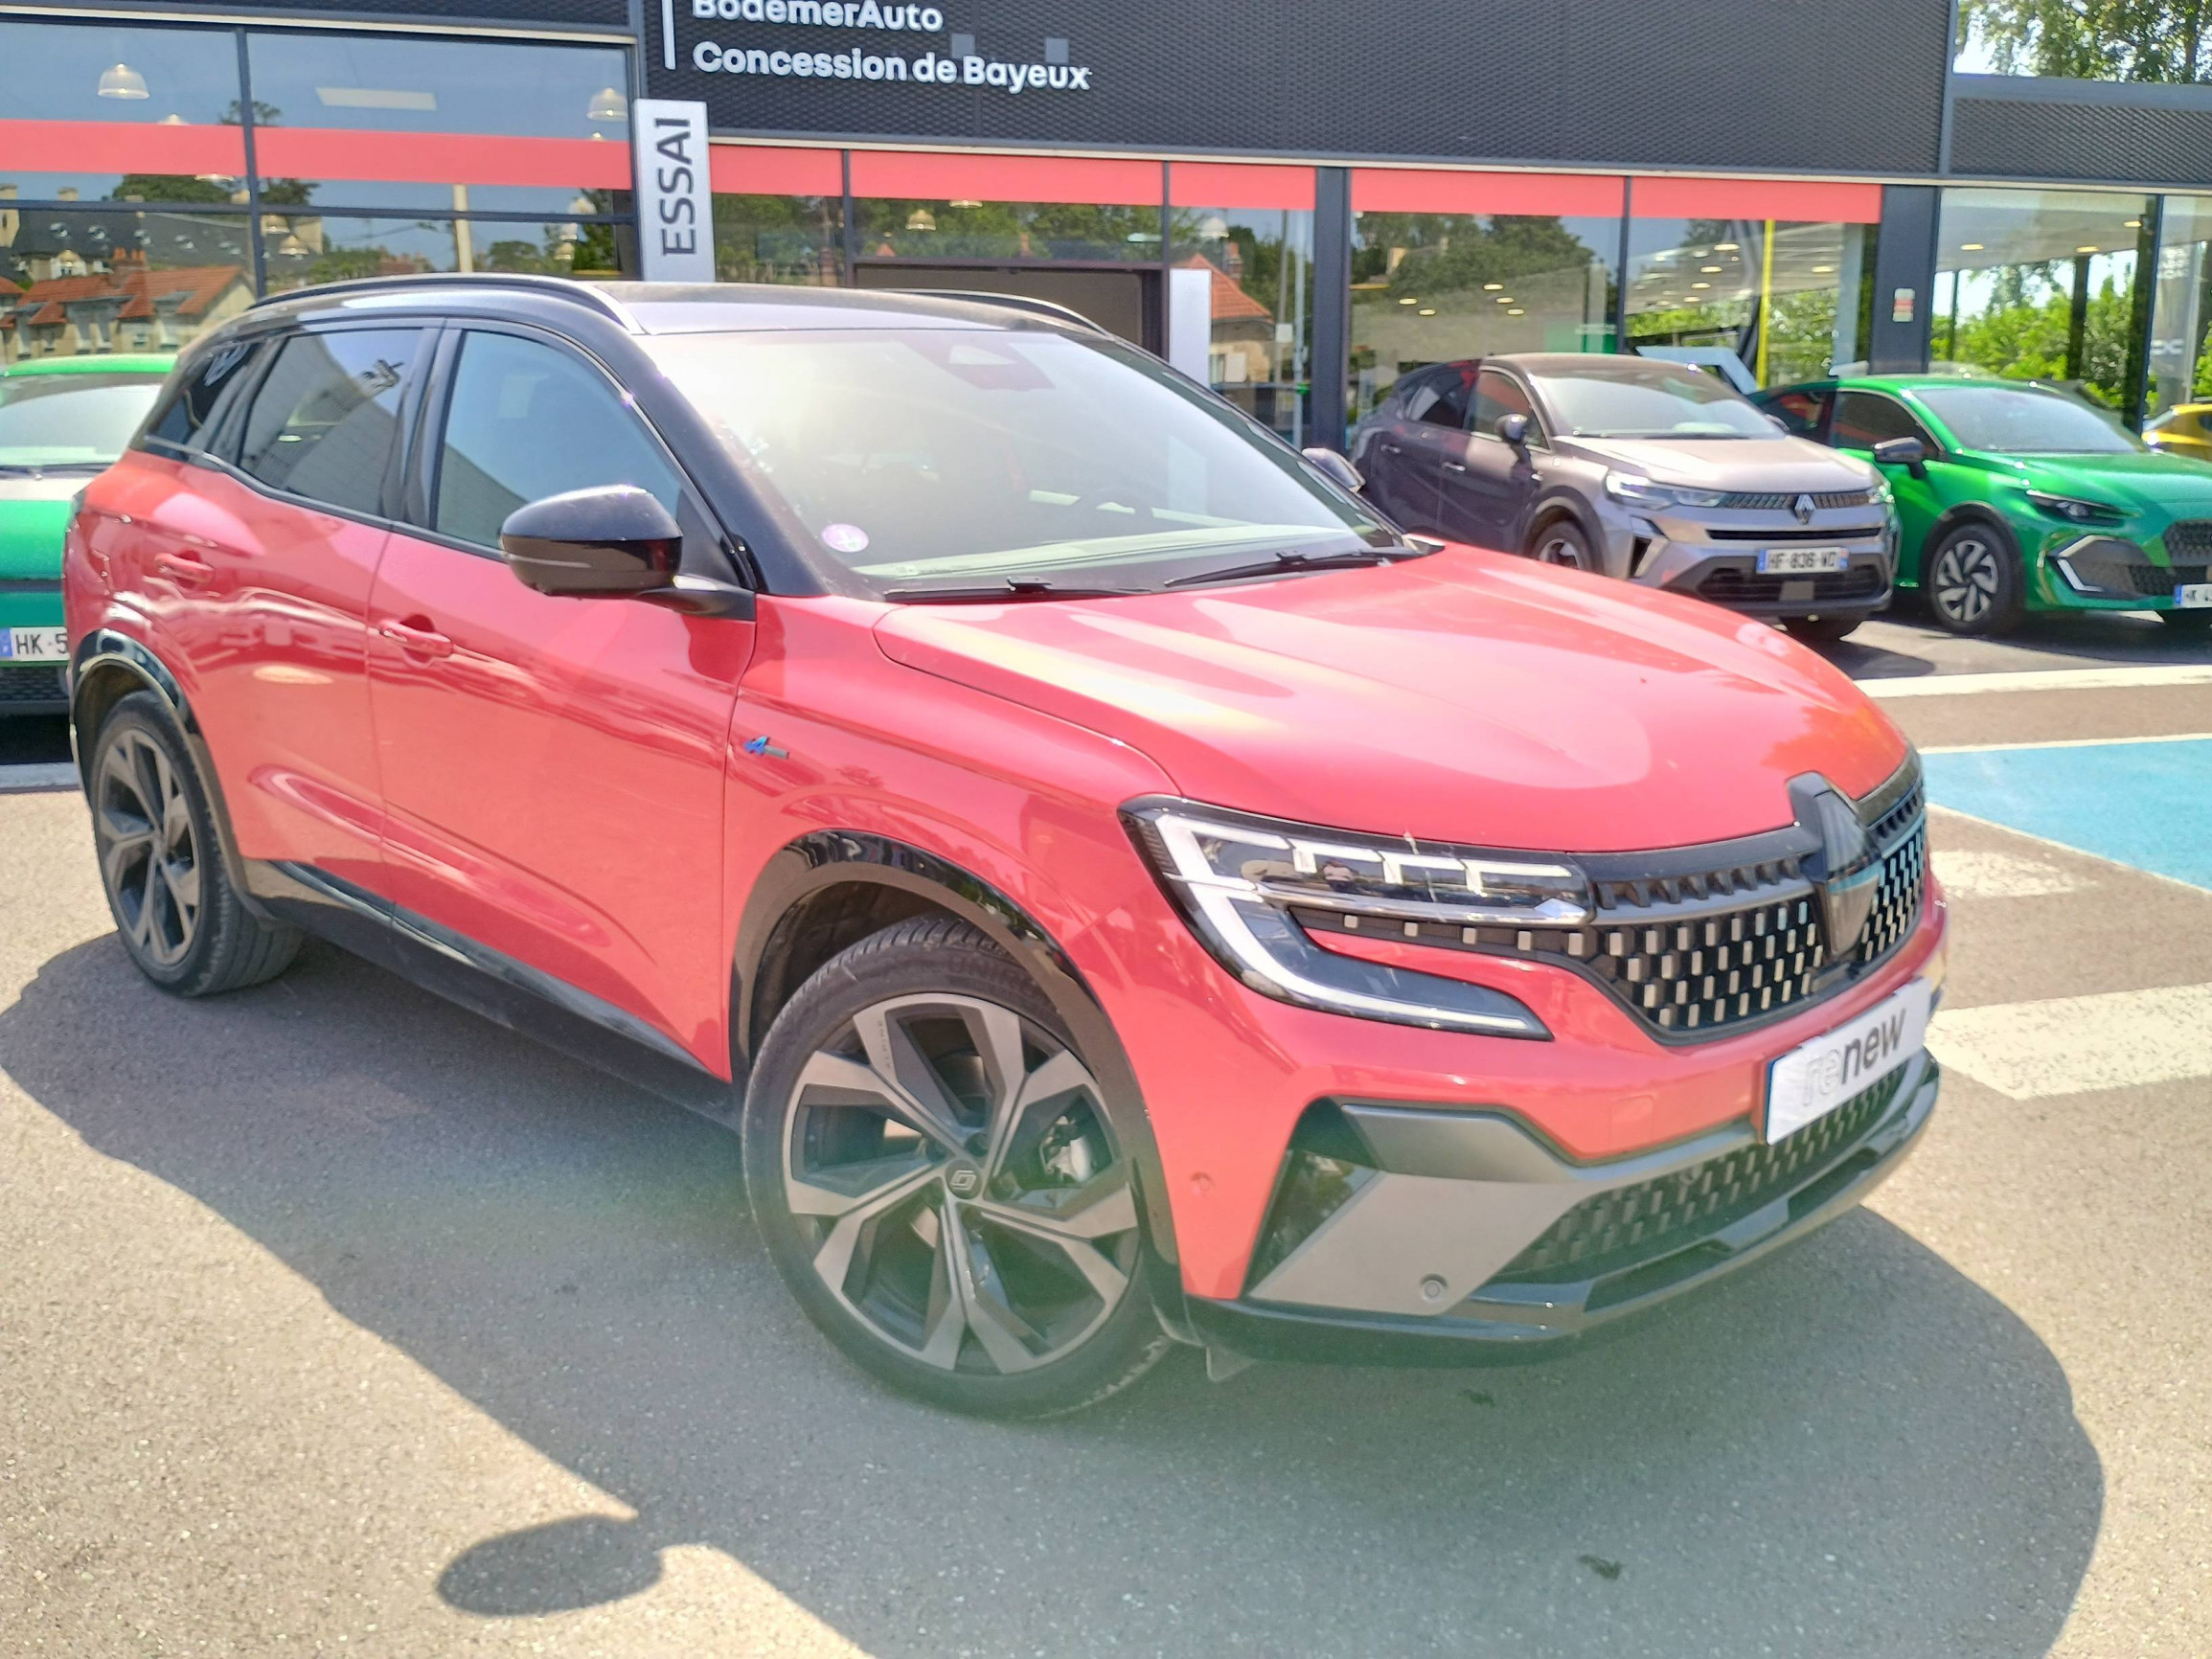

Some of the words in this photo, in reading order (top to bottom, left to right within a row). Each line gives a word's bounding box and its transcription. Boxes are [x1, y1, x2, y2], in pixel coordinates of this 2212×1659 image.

[693, 0, 944, 32] BodemerAuto
[693, 41, 907, 80] Concession
[912, 52, 957, 84] de
[963, 56, 1091, 94] Bayeux
[654, 117, 696, 257] ESSAI
[1802, 1008, 1907, 1107] renew
